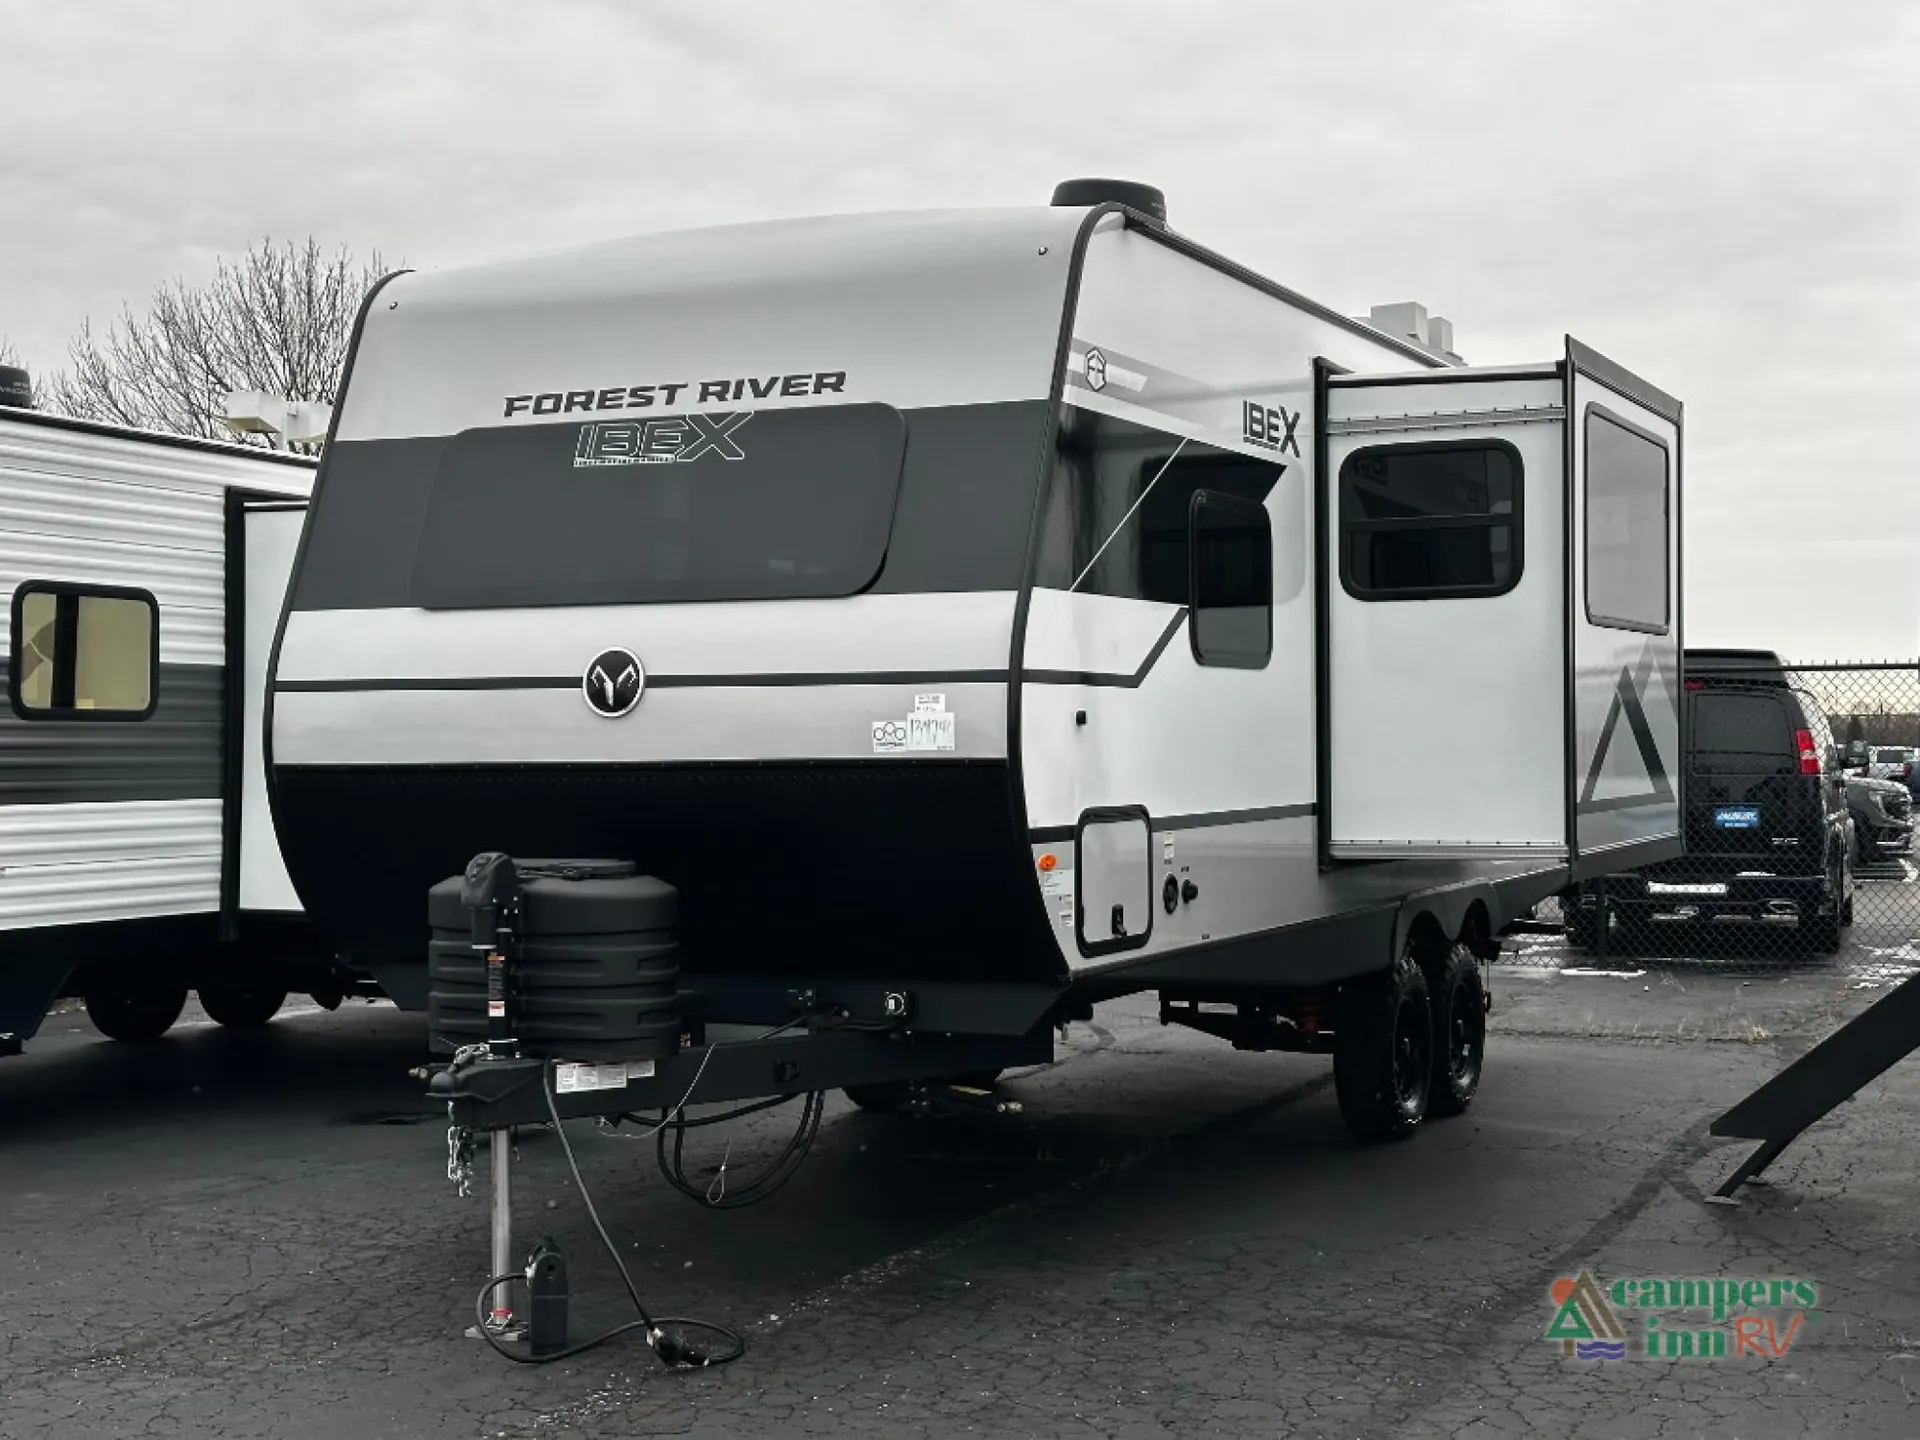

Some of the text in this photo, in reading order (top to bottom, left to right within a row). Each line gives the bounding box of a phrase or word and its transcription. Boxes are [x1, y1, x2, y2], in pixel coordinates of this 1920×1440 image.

[503, 370, 847, 417] FOREST RIVER
[574, 410, 755, 463] IBEX
[1242, 400, 1300, 458] IBEX
